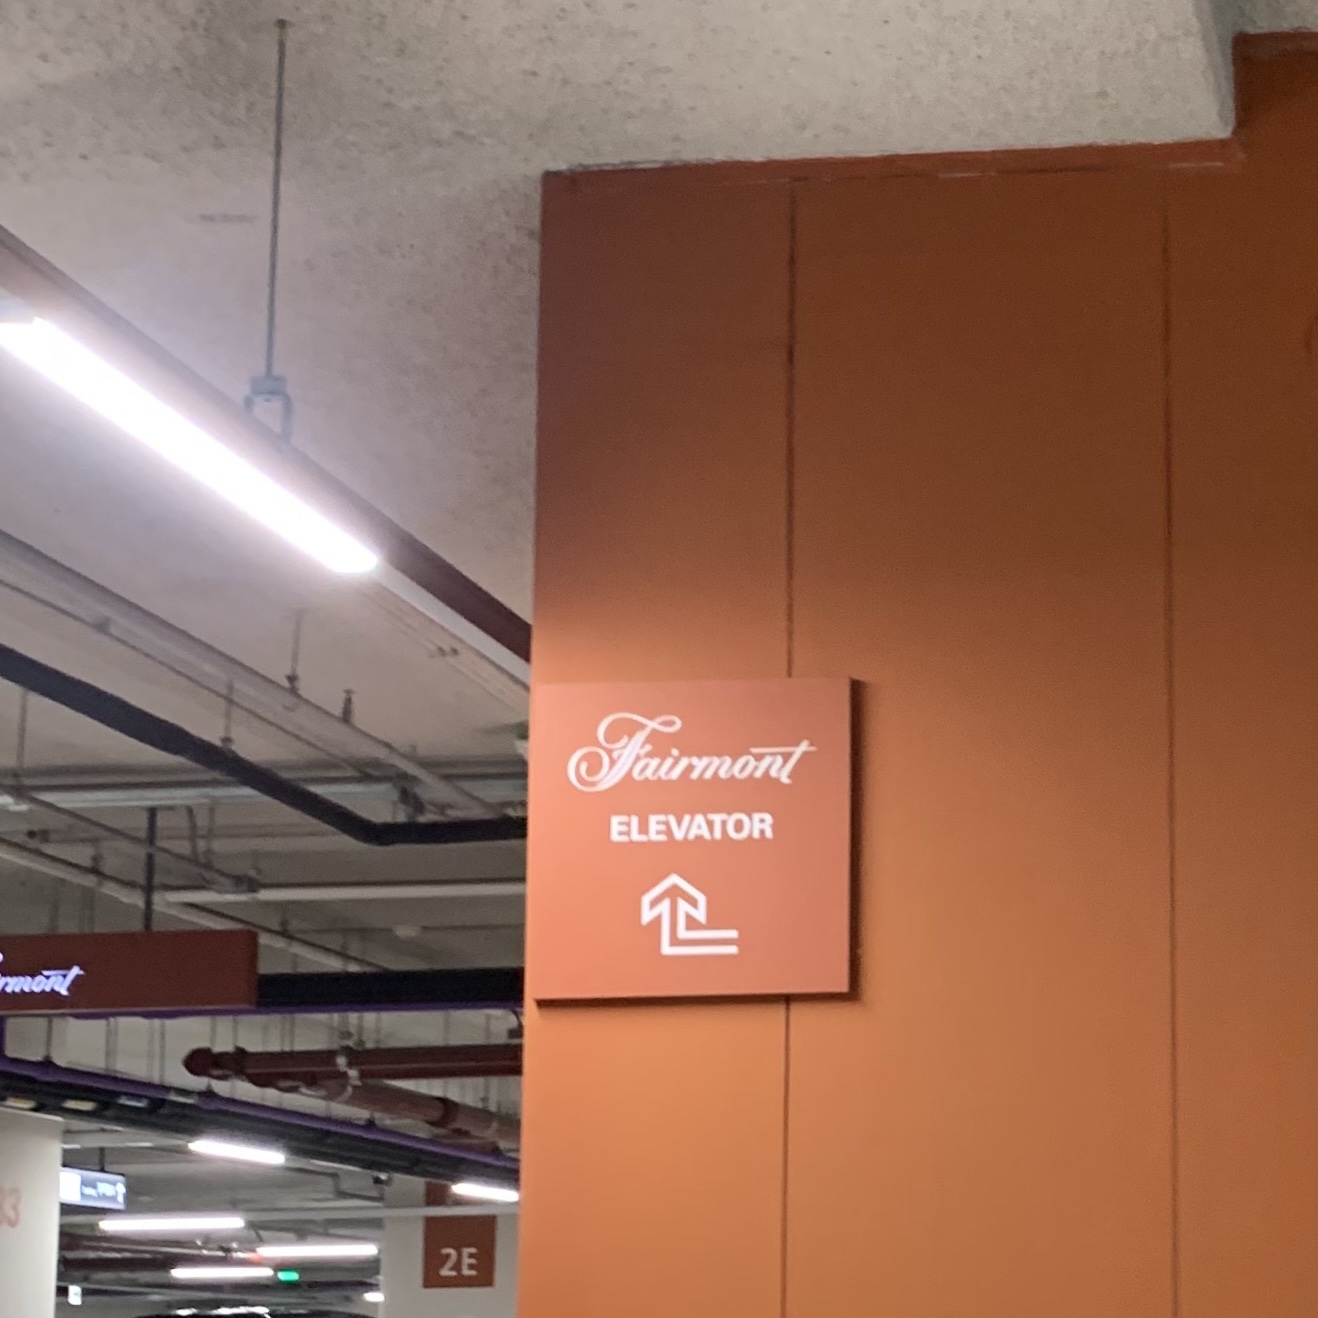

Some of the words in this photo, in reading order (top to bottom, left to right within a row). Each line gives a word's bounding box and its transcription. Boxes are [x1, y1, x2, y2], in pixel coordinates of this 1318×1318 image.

[567, 712, 818, 792] Fairmont
[610, 812, 774, 842] ELEVATOR
[0, 953, 85, 996] rmont
[439, 1247, 478, 1276] 2E
